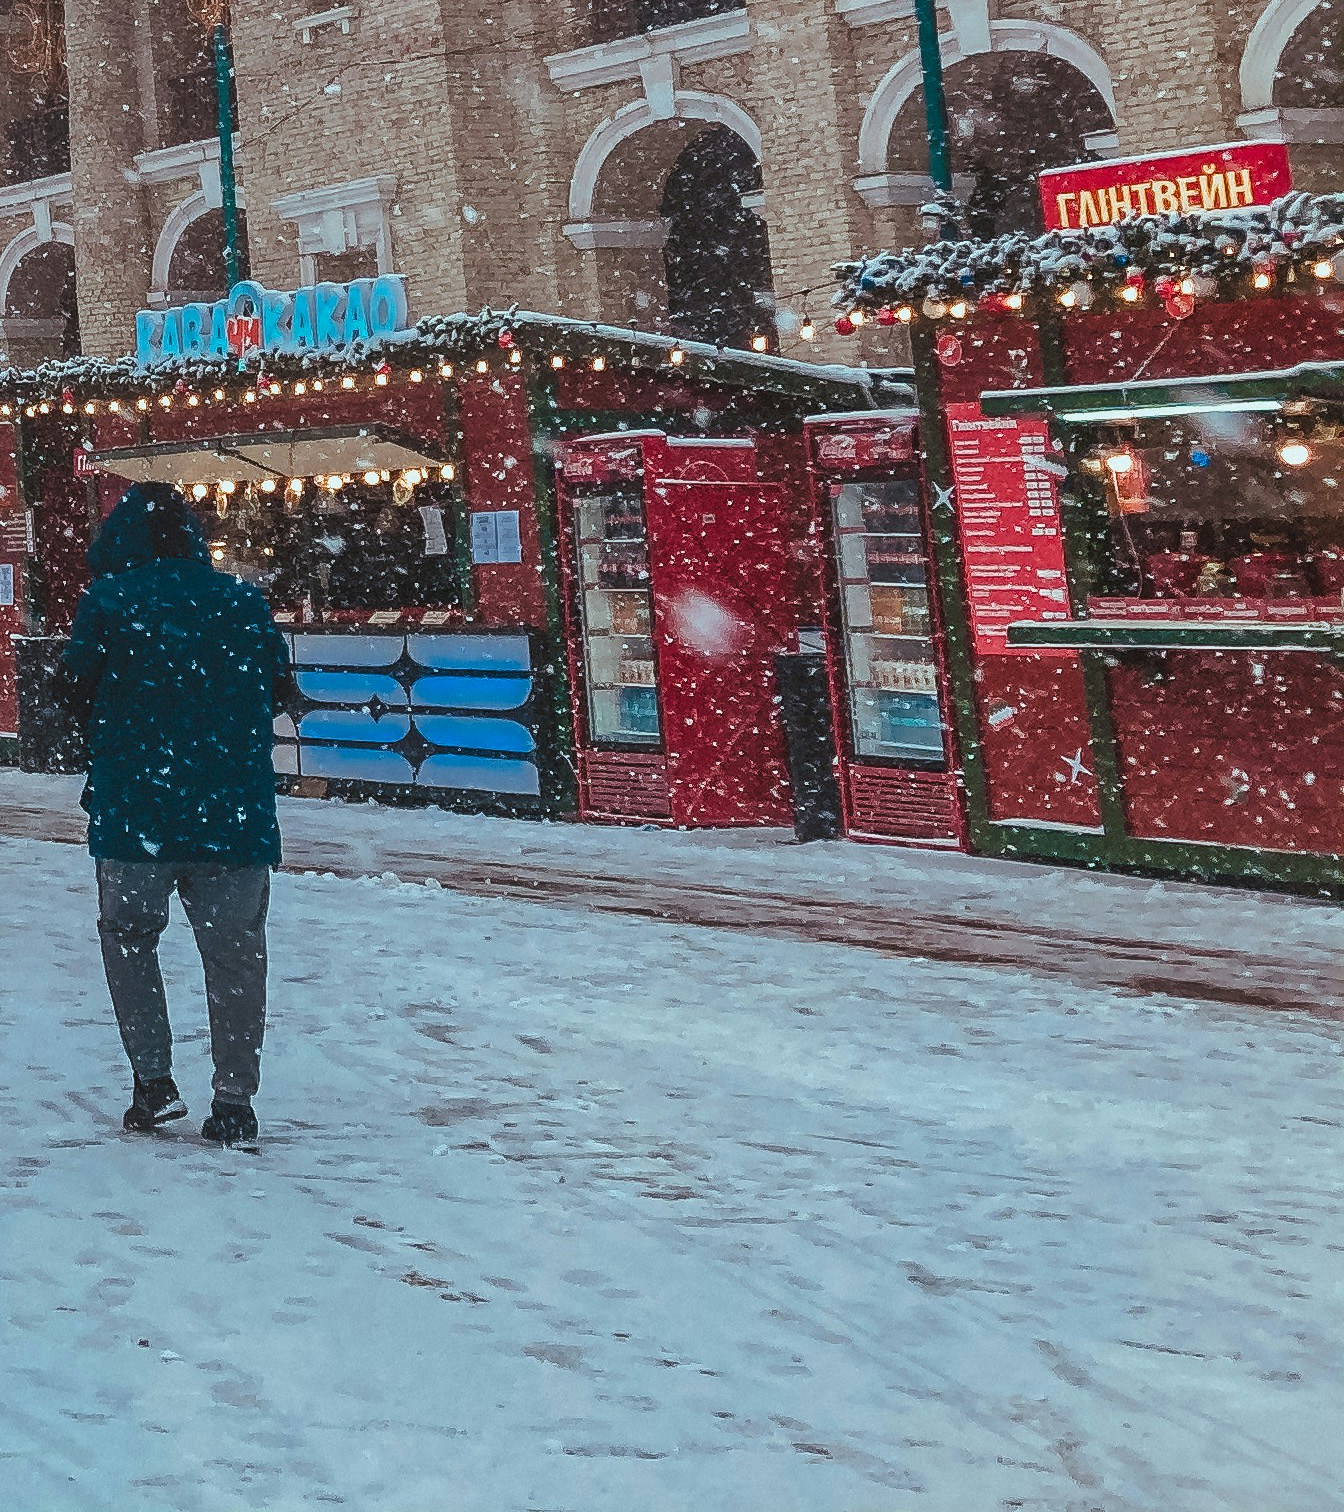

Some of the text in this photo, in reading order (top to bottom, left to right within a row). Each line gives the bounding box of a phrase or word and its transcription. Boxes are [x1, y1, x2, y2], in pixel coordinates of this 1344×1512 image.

[1055, 162, 1254, 228] ГЛІНТВЕЙН
[137, 304, 229, 369] КАВА
[263, 276, 400, 353] КАКАО
